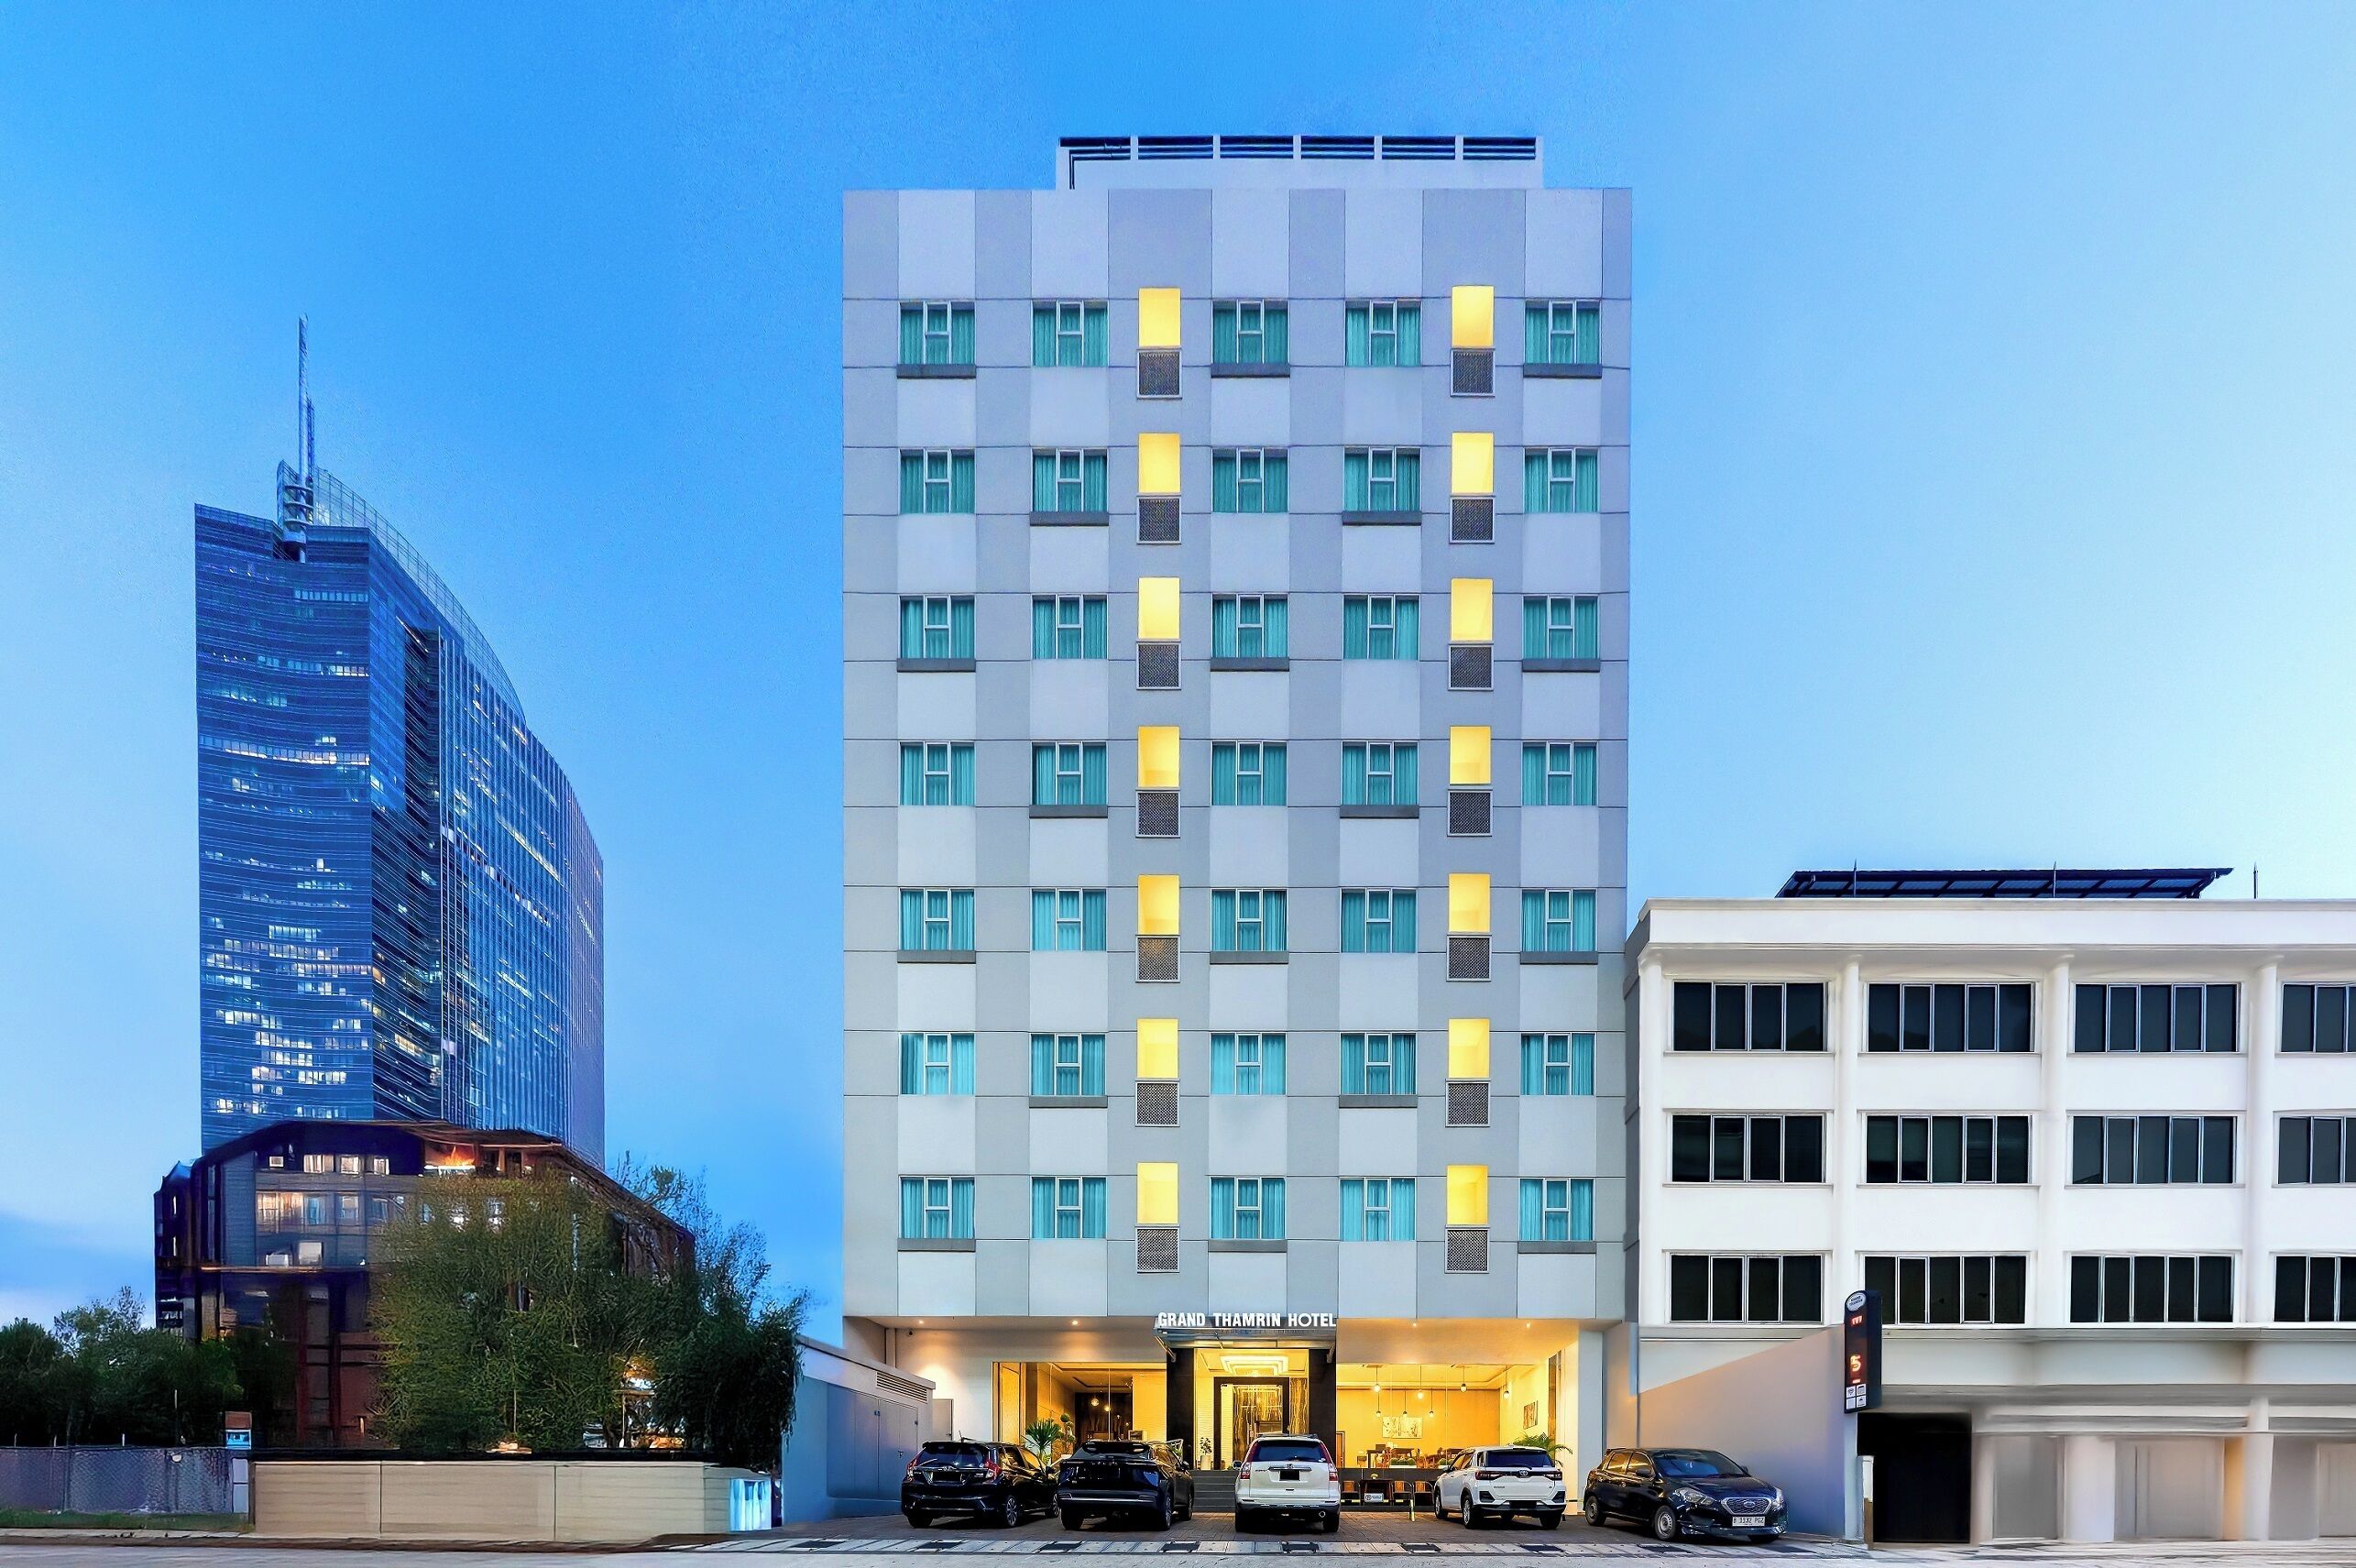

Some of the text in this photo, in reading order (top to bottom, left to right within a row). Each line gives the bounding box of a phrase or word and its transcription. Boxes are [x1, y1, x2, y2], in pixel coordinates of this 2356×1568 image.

[1157, 1312, 1337, 1327] GRAND THAMRIN HOTEL
